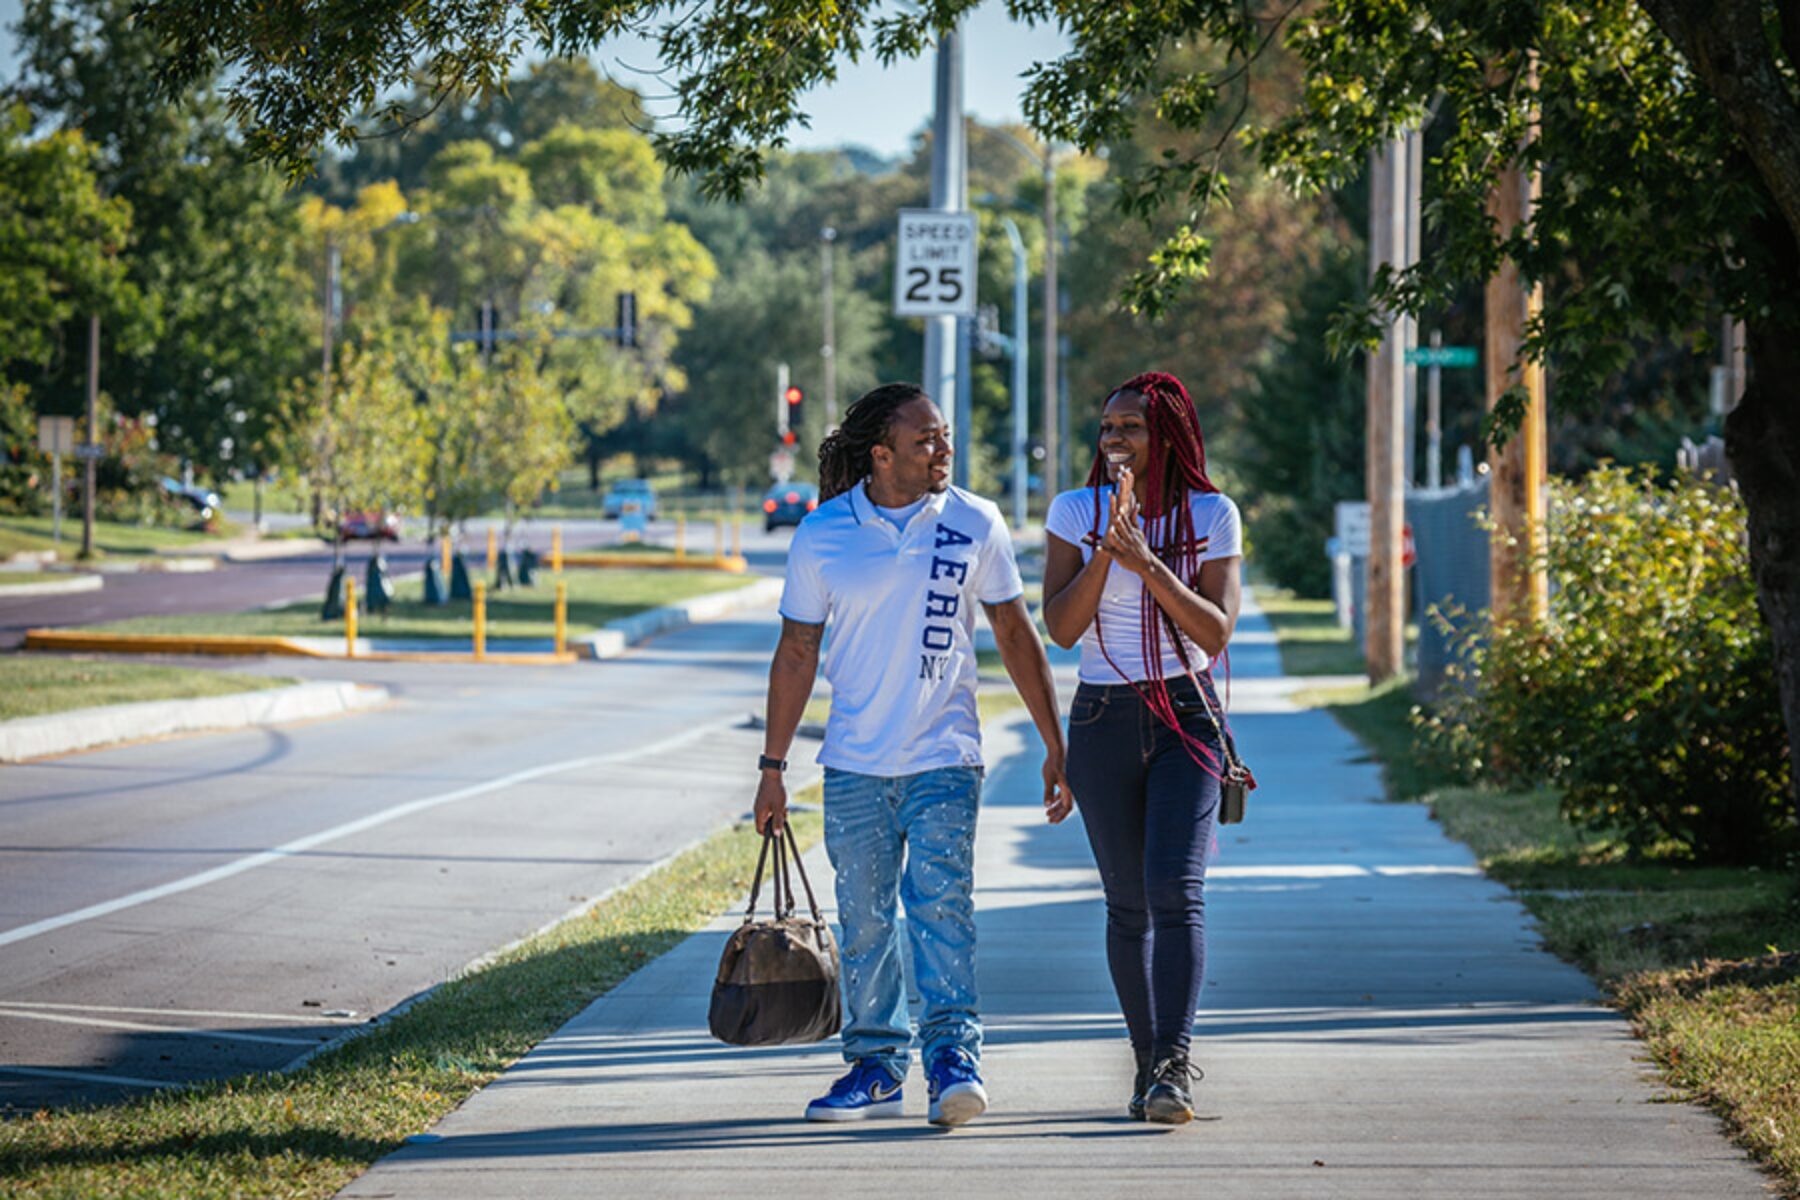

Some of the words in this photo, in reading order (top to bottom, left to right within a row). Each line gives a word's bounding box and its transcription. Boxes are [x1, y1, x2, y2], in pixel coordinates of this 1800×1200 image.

[905, 223, 968, 240] SPEED
[911, 245, 960, 261] LIMIT
[906, 266, 963, 303] 25
[922, 522, 973, 651] AERO
